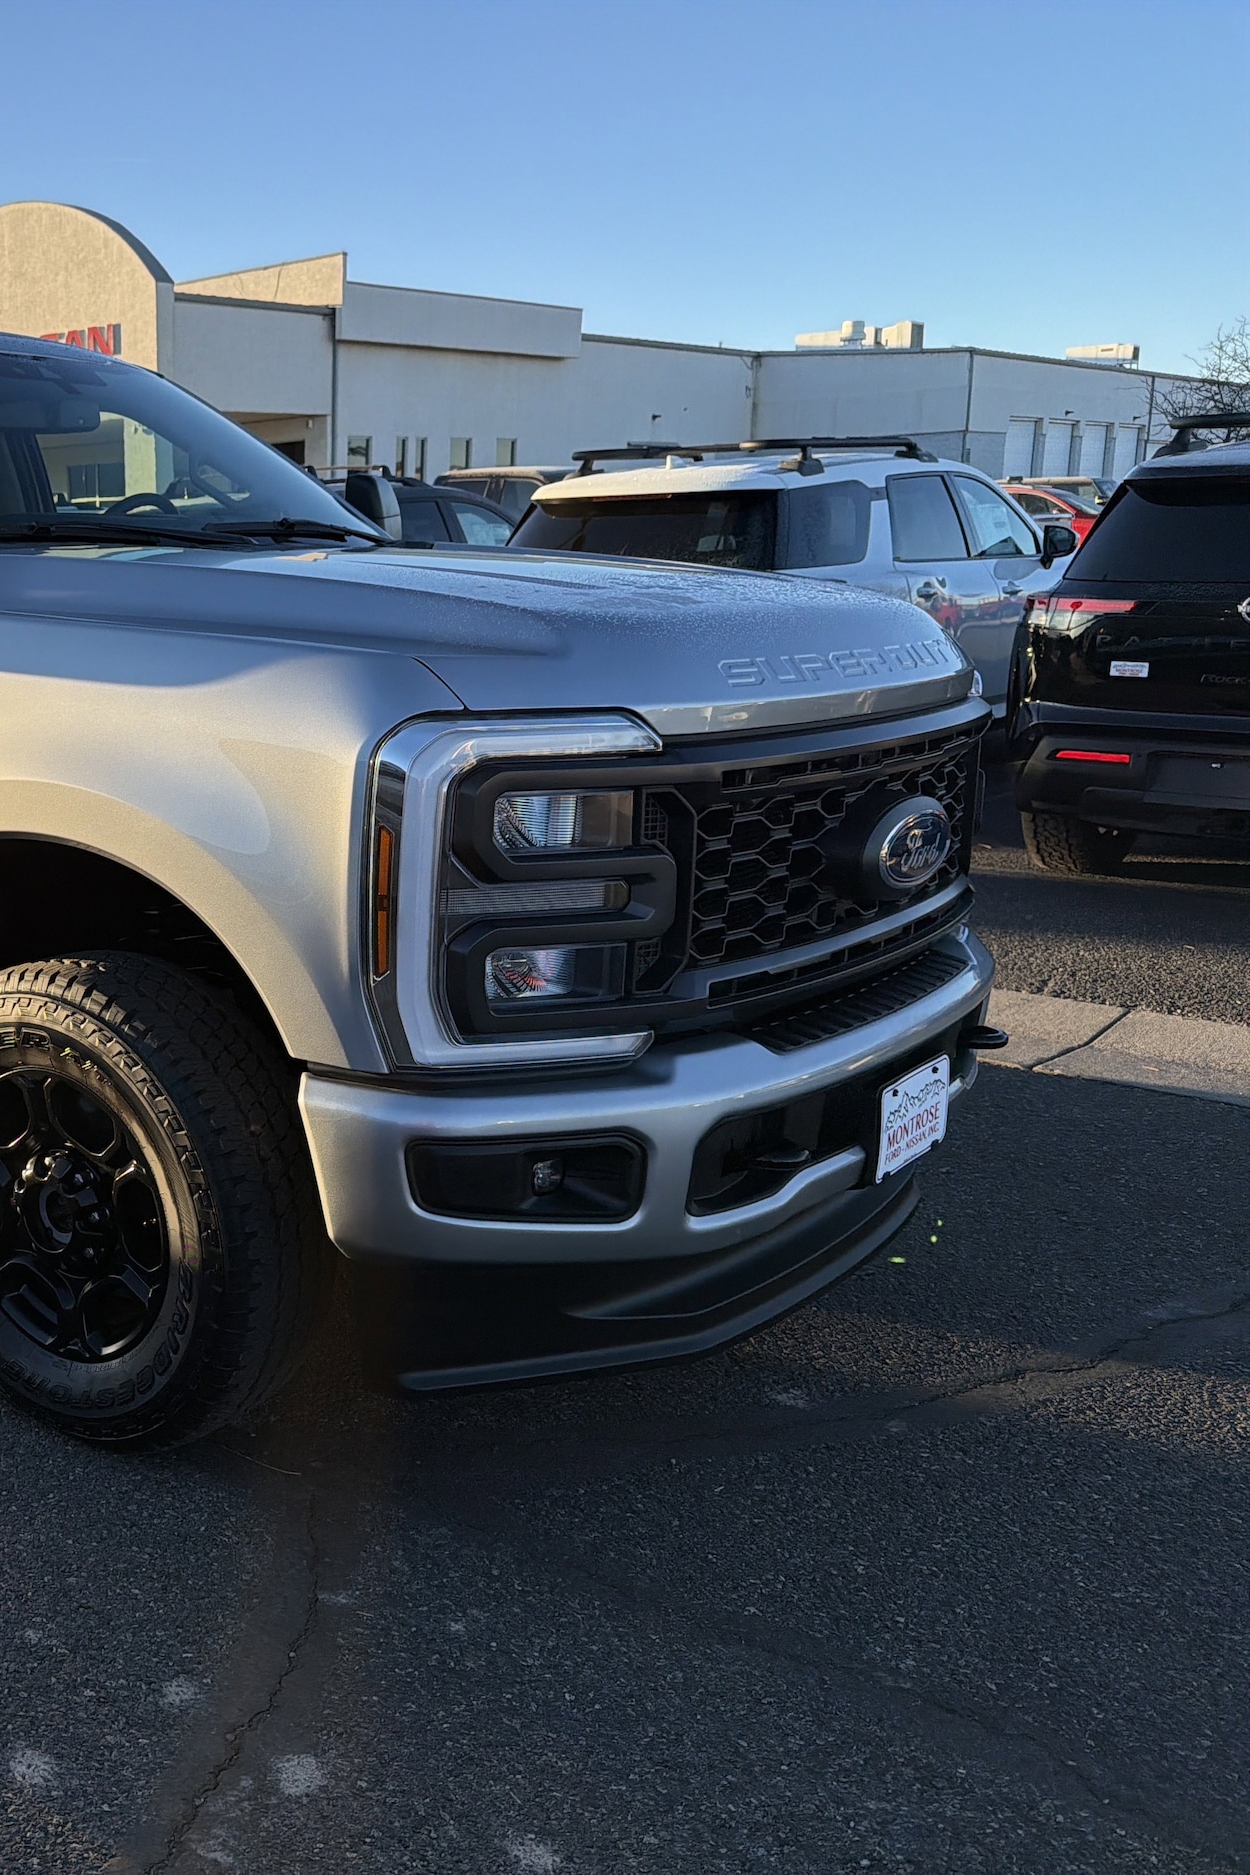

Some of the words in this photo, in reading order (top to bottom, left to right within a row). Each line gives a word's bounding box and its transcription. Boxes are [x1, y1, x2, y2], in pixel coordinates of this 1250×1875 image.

[718, 648, 892, 688] SUPER
[899, 819, 942, 872] Ford
[886, 1101, 940, 1152] MONTROSE
[884, 1145, 901, 1166] FORD
[2, 1256, 195, 1408] BRIDGESTONE
